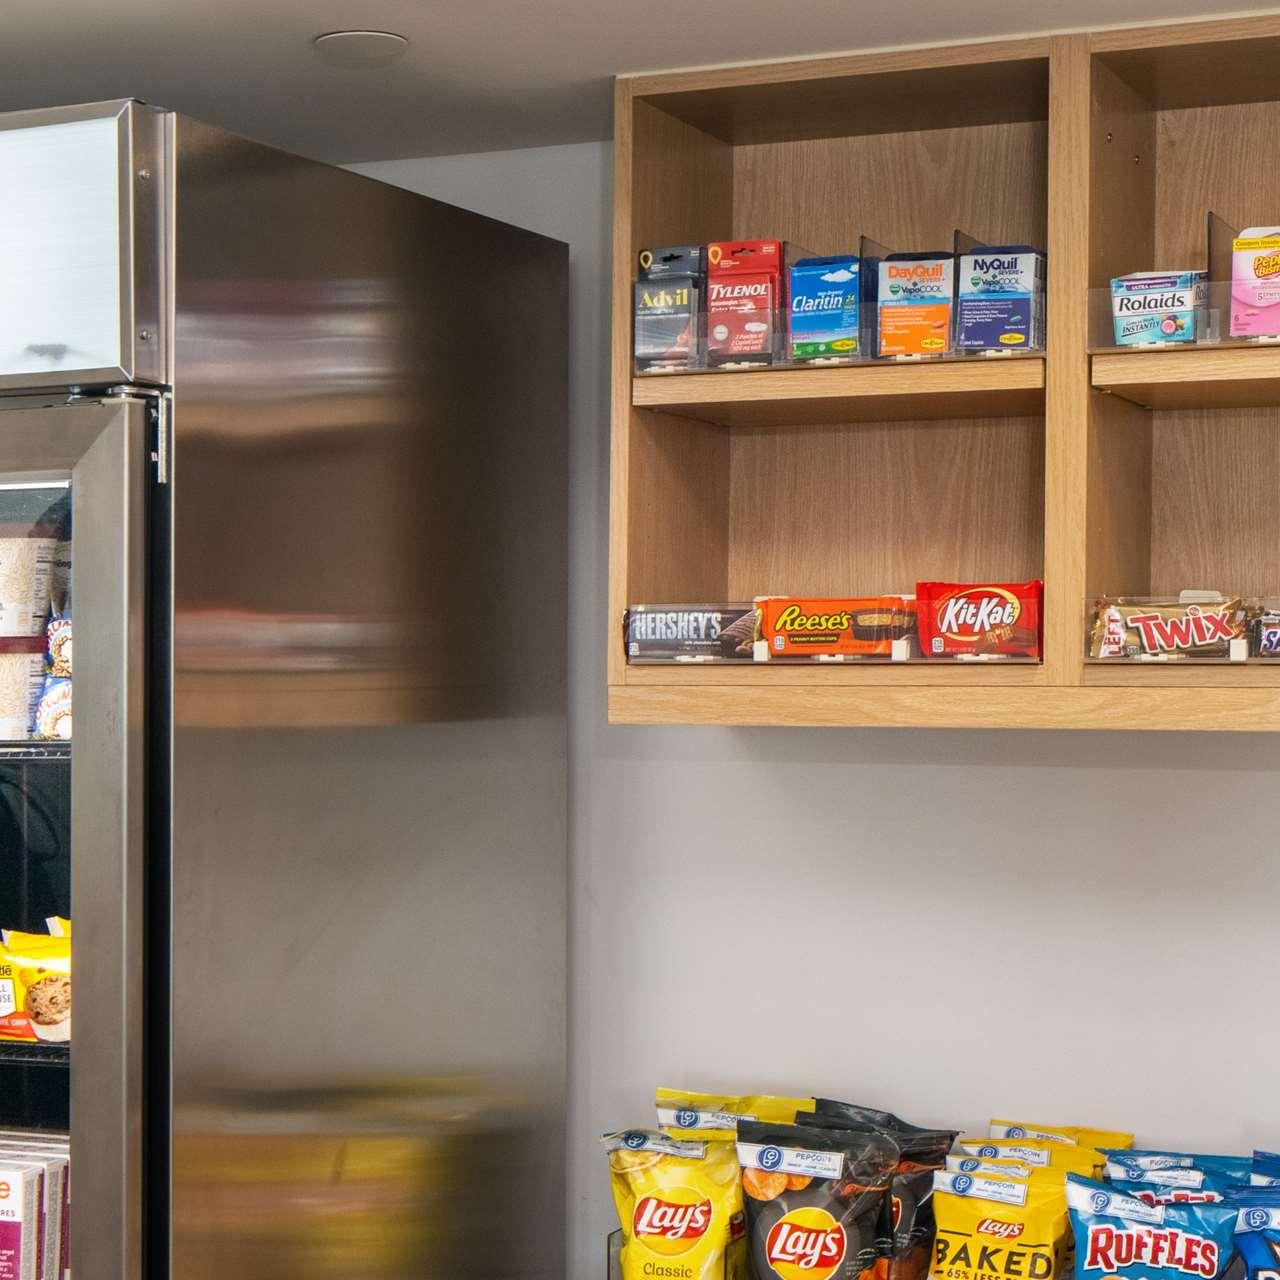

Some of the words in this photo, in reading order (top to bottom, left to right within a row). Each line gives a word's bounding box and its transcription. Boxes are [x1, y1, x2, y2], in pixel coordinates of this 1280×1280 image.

[888, 264, 943, 281] DayQuil
[973, 257, 1018, 276] NyQuil
[639, 288, 688, 308] Advil
[711, 283, 768, 300] TYLENOL
[792, 295, 843, 312] Claritin
[1119, 293, 1185, 311] Rolaids
[635, 611, 722, 641] HERSHEY'S
[1129, 606, 1233, 653] Twix
[636, 1196, 709, 1231] Lay's
[977, 1219, 1024, 1238] Lay's
[770, 1223, 843, 1268] Lay's
[1086, 1226, 1219, 1278] RUFFLES
[935, 1239, 1052, 1280] BAKED
[643, 1261, 693, 1279] Classic
[947, 1268, 969, 1279] 65%
